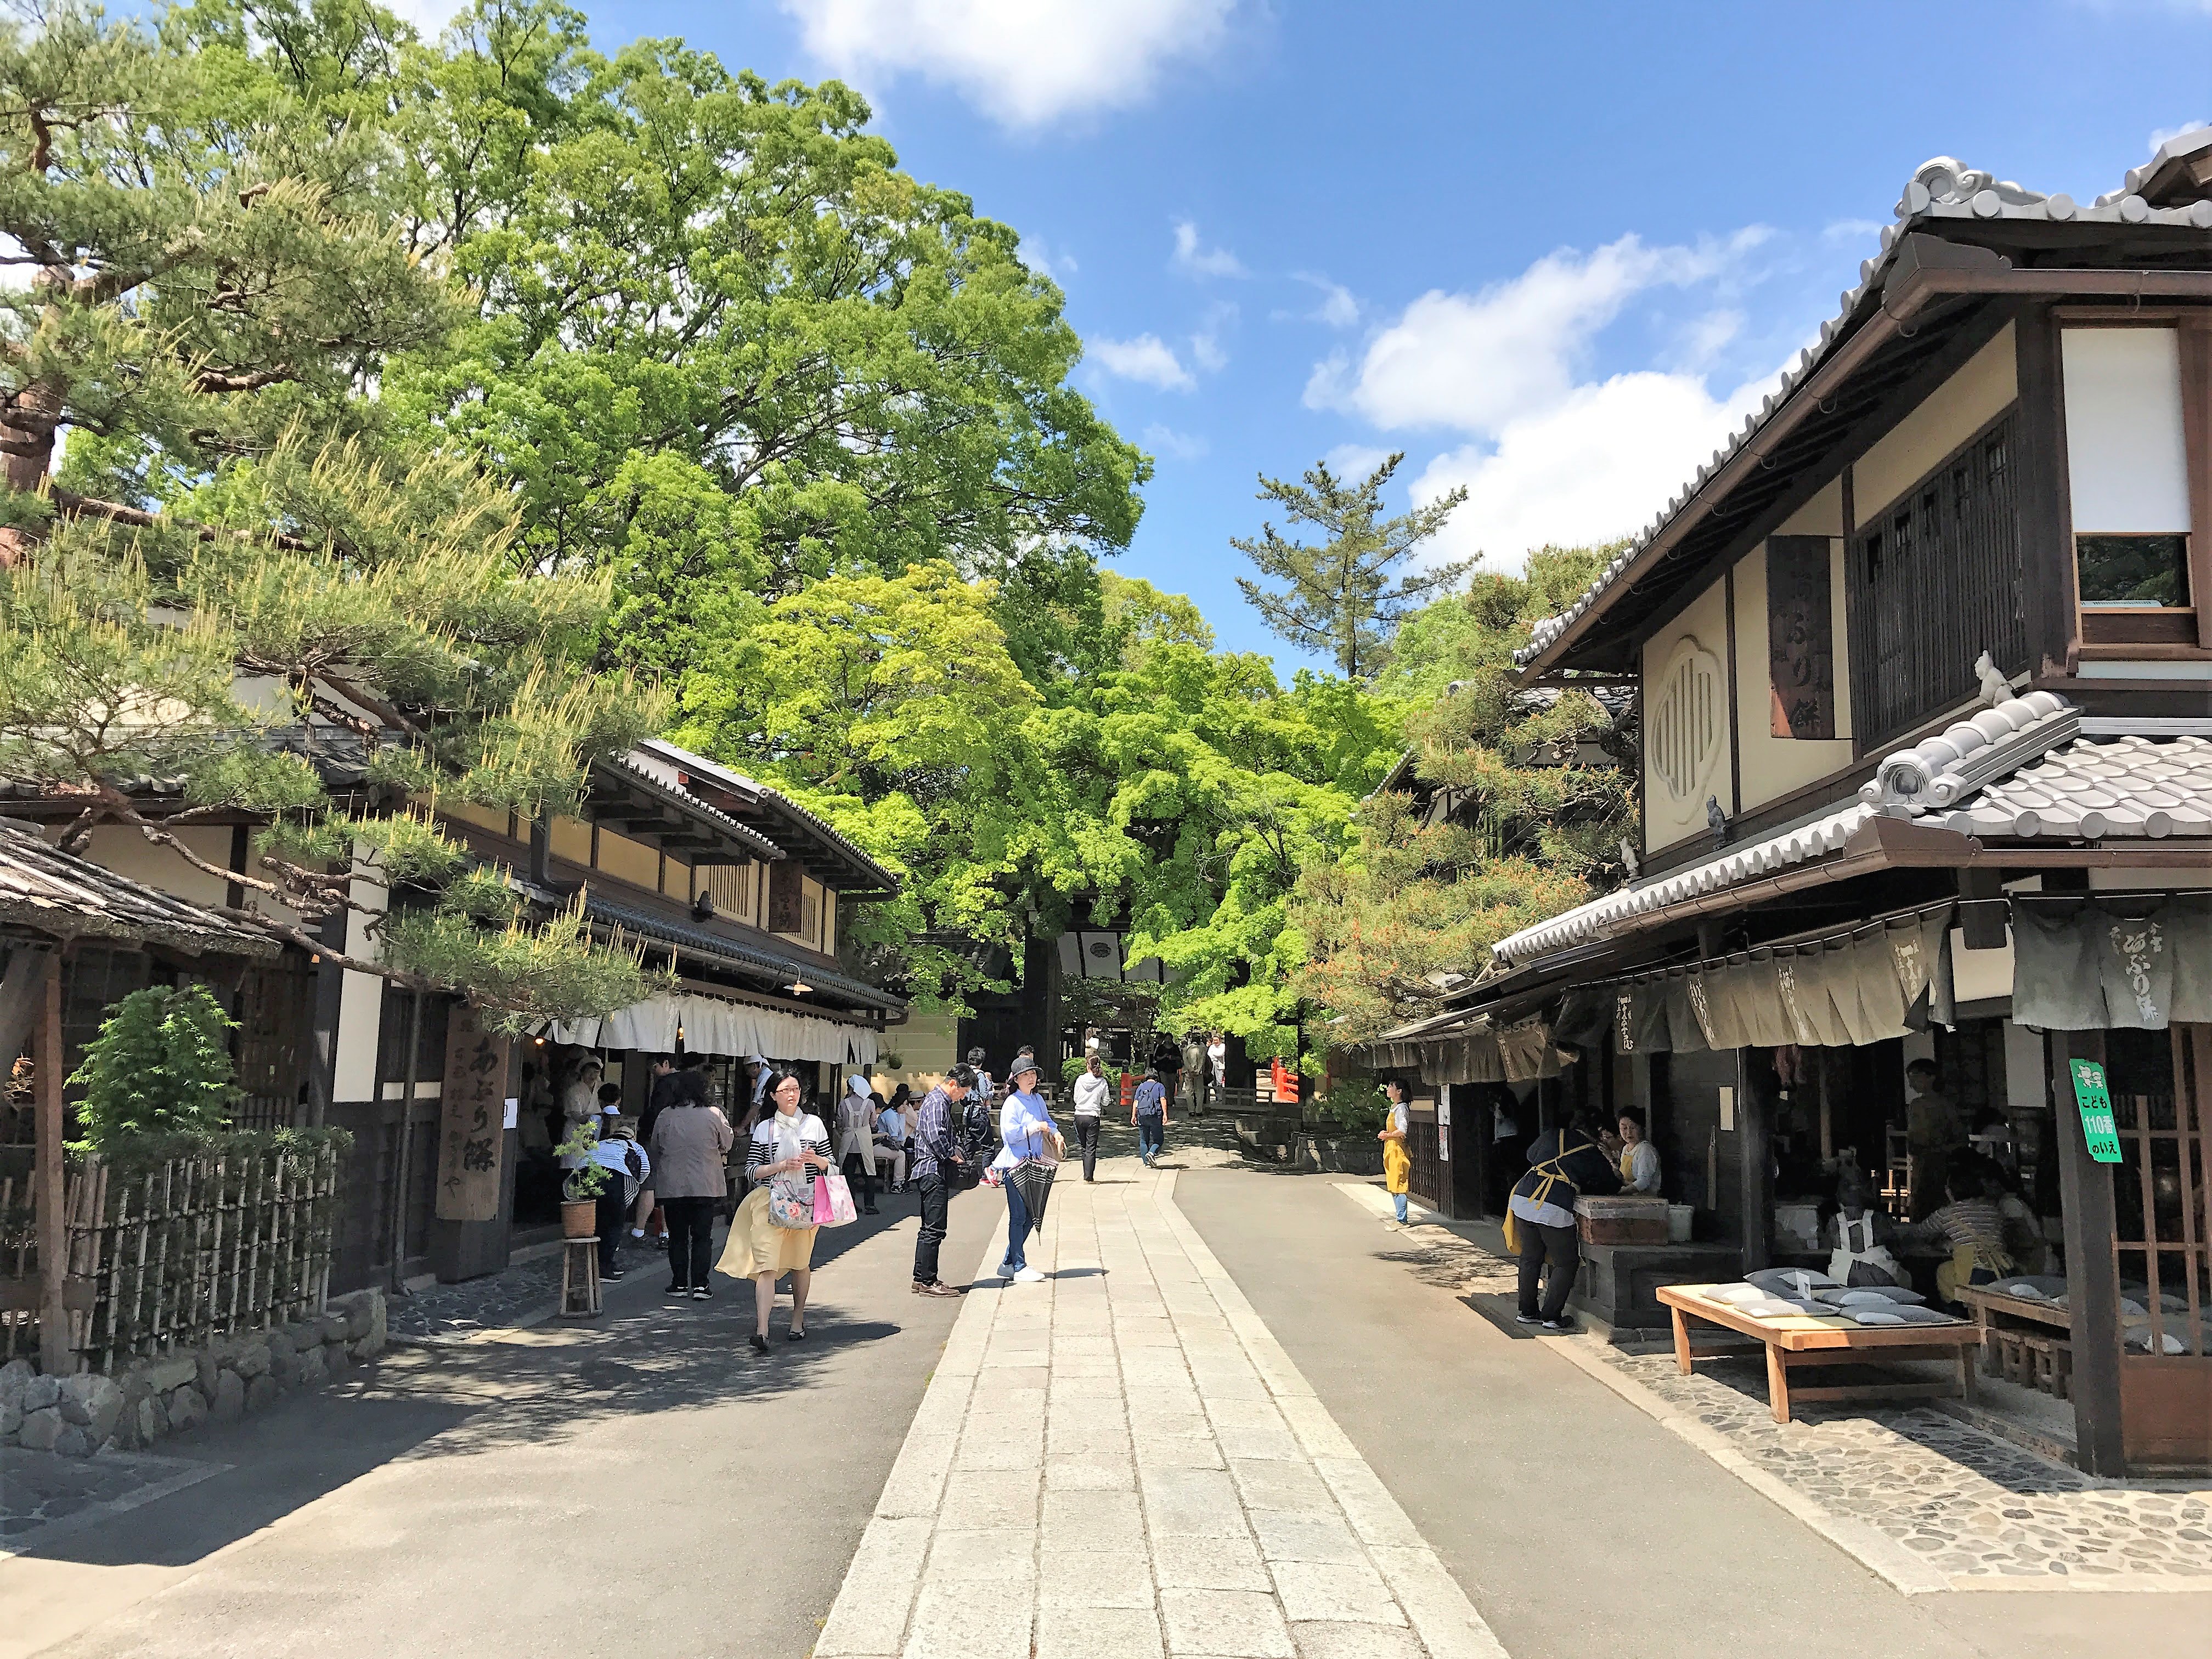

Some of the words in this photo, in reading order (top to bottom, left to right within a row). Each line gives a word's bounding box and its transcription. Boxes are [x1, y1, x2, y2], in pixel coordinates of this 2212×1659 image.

[2123, 931, 2158, 1022] あぶり餅
[463, 1036, 499, 1172] あぶり餅
[2081, 1095, 2107, 1109] こども
[2085, 1115, 2113, 1135] 110番
[2092, 1141, 2117, 1154] のいえ
